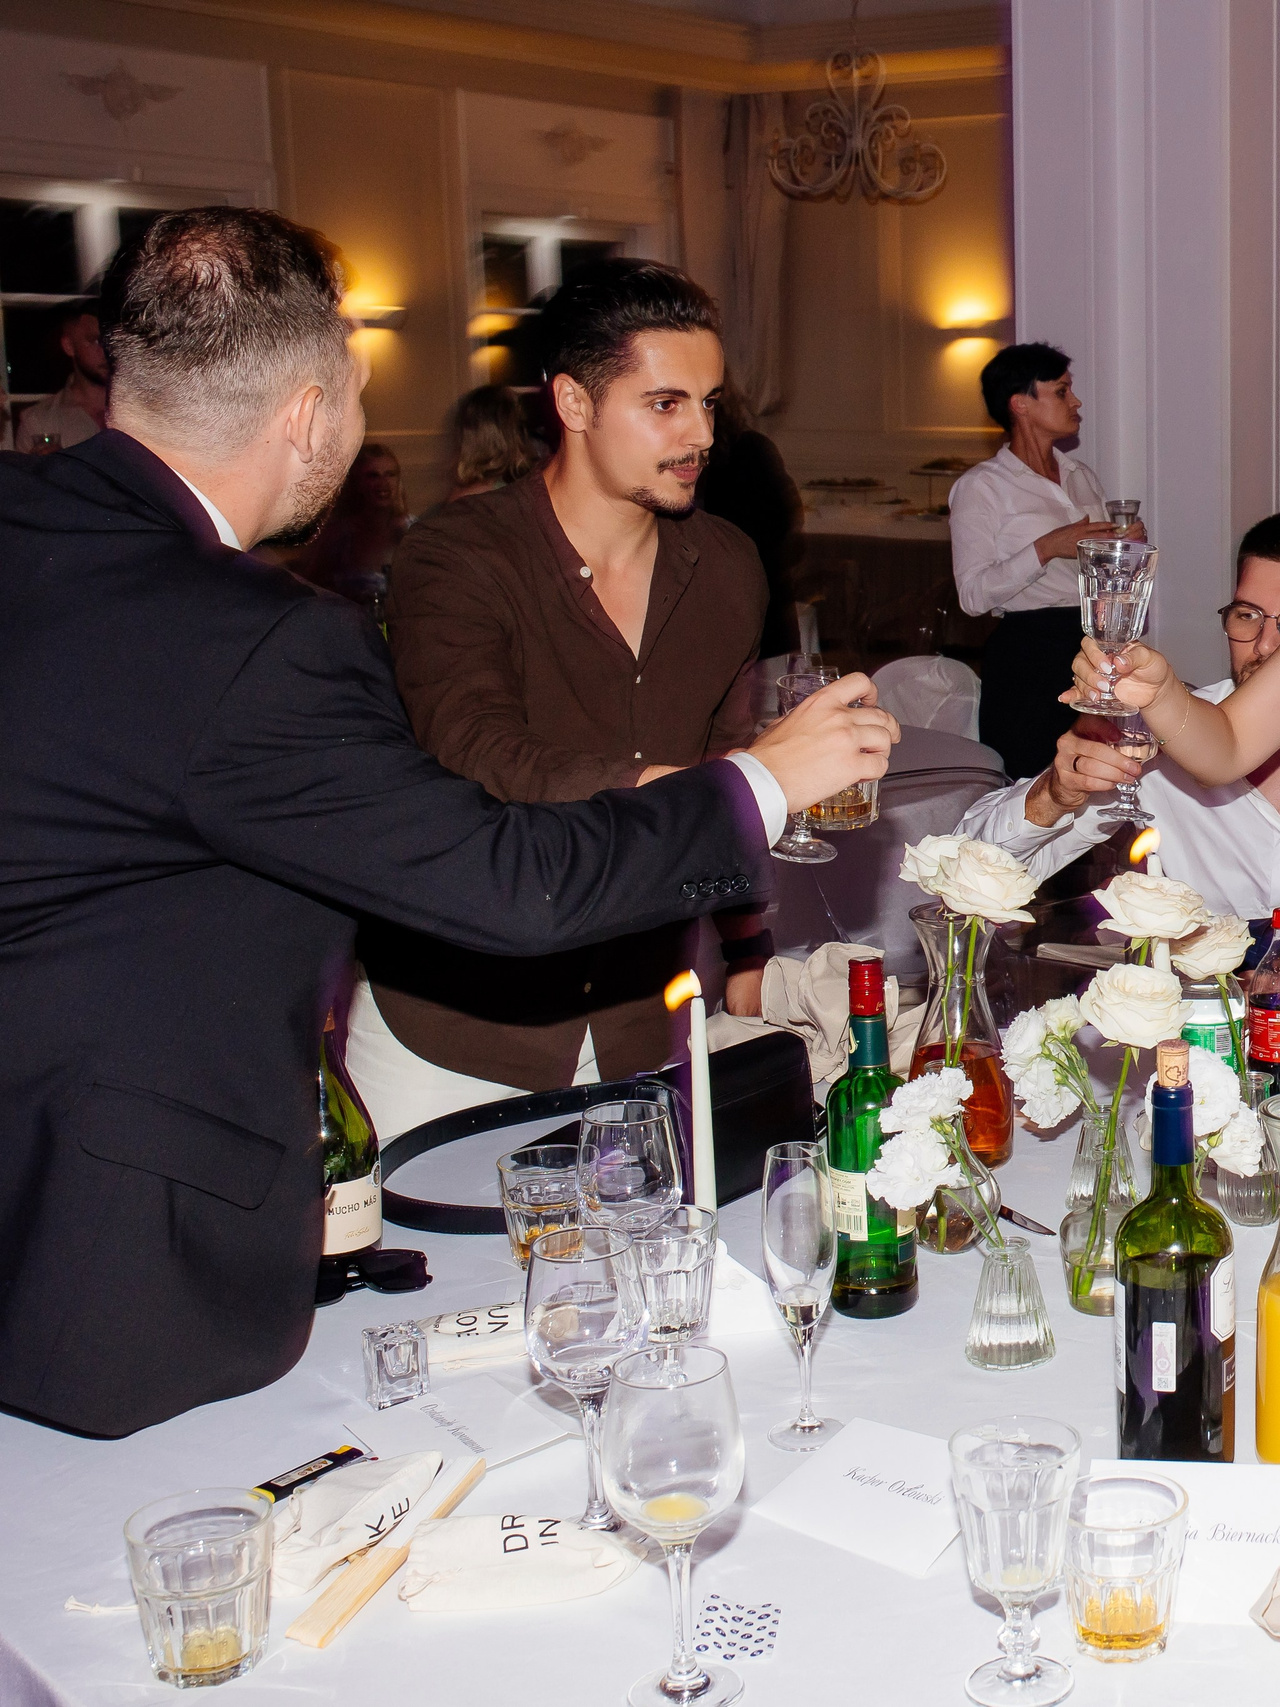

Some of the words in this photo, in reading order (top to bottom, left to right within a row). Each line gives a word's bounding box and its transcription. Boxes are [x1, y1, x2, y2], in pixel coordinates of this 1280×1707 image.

[327, 1203, 360, 1216] MUCHO
[363, 1195, 377, 1208] MÁS
[843, 1466, 888, 1487] Kacper
